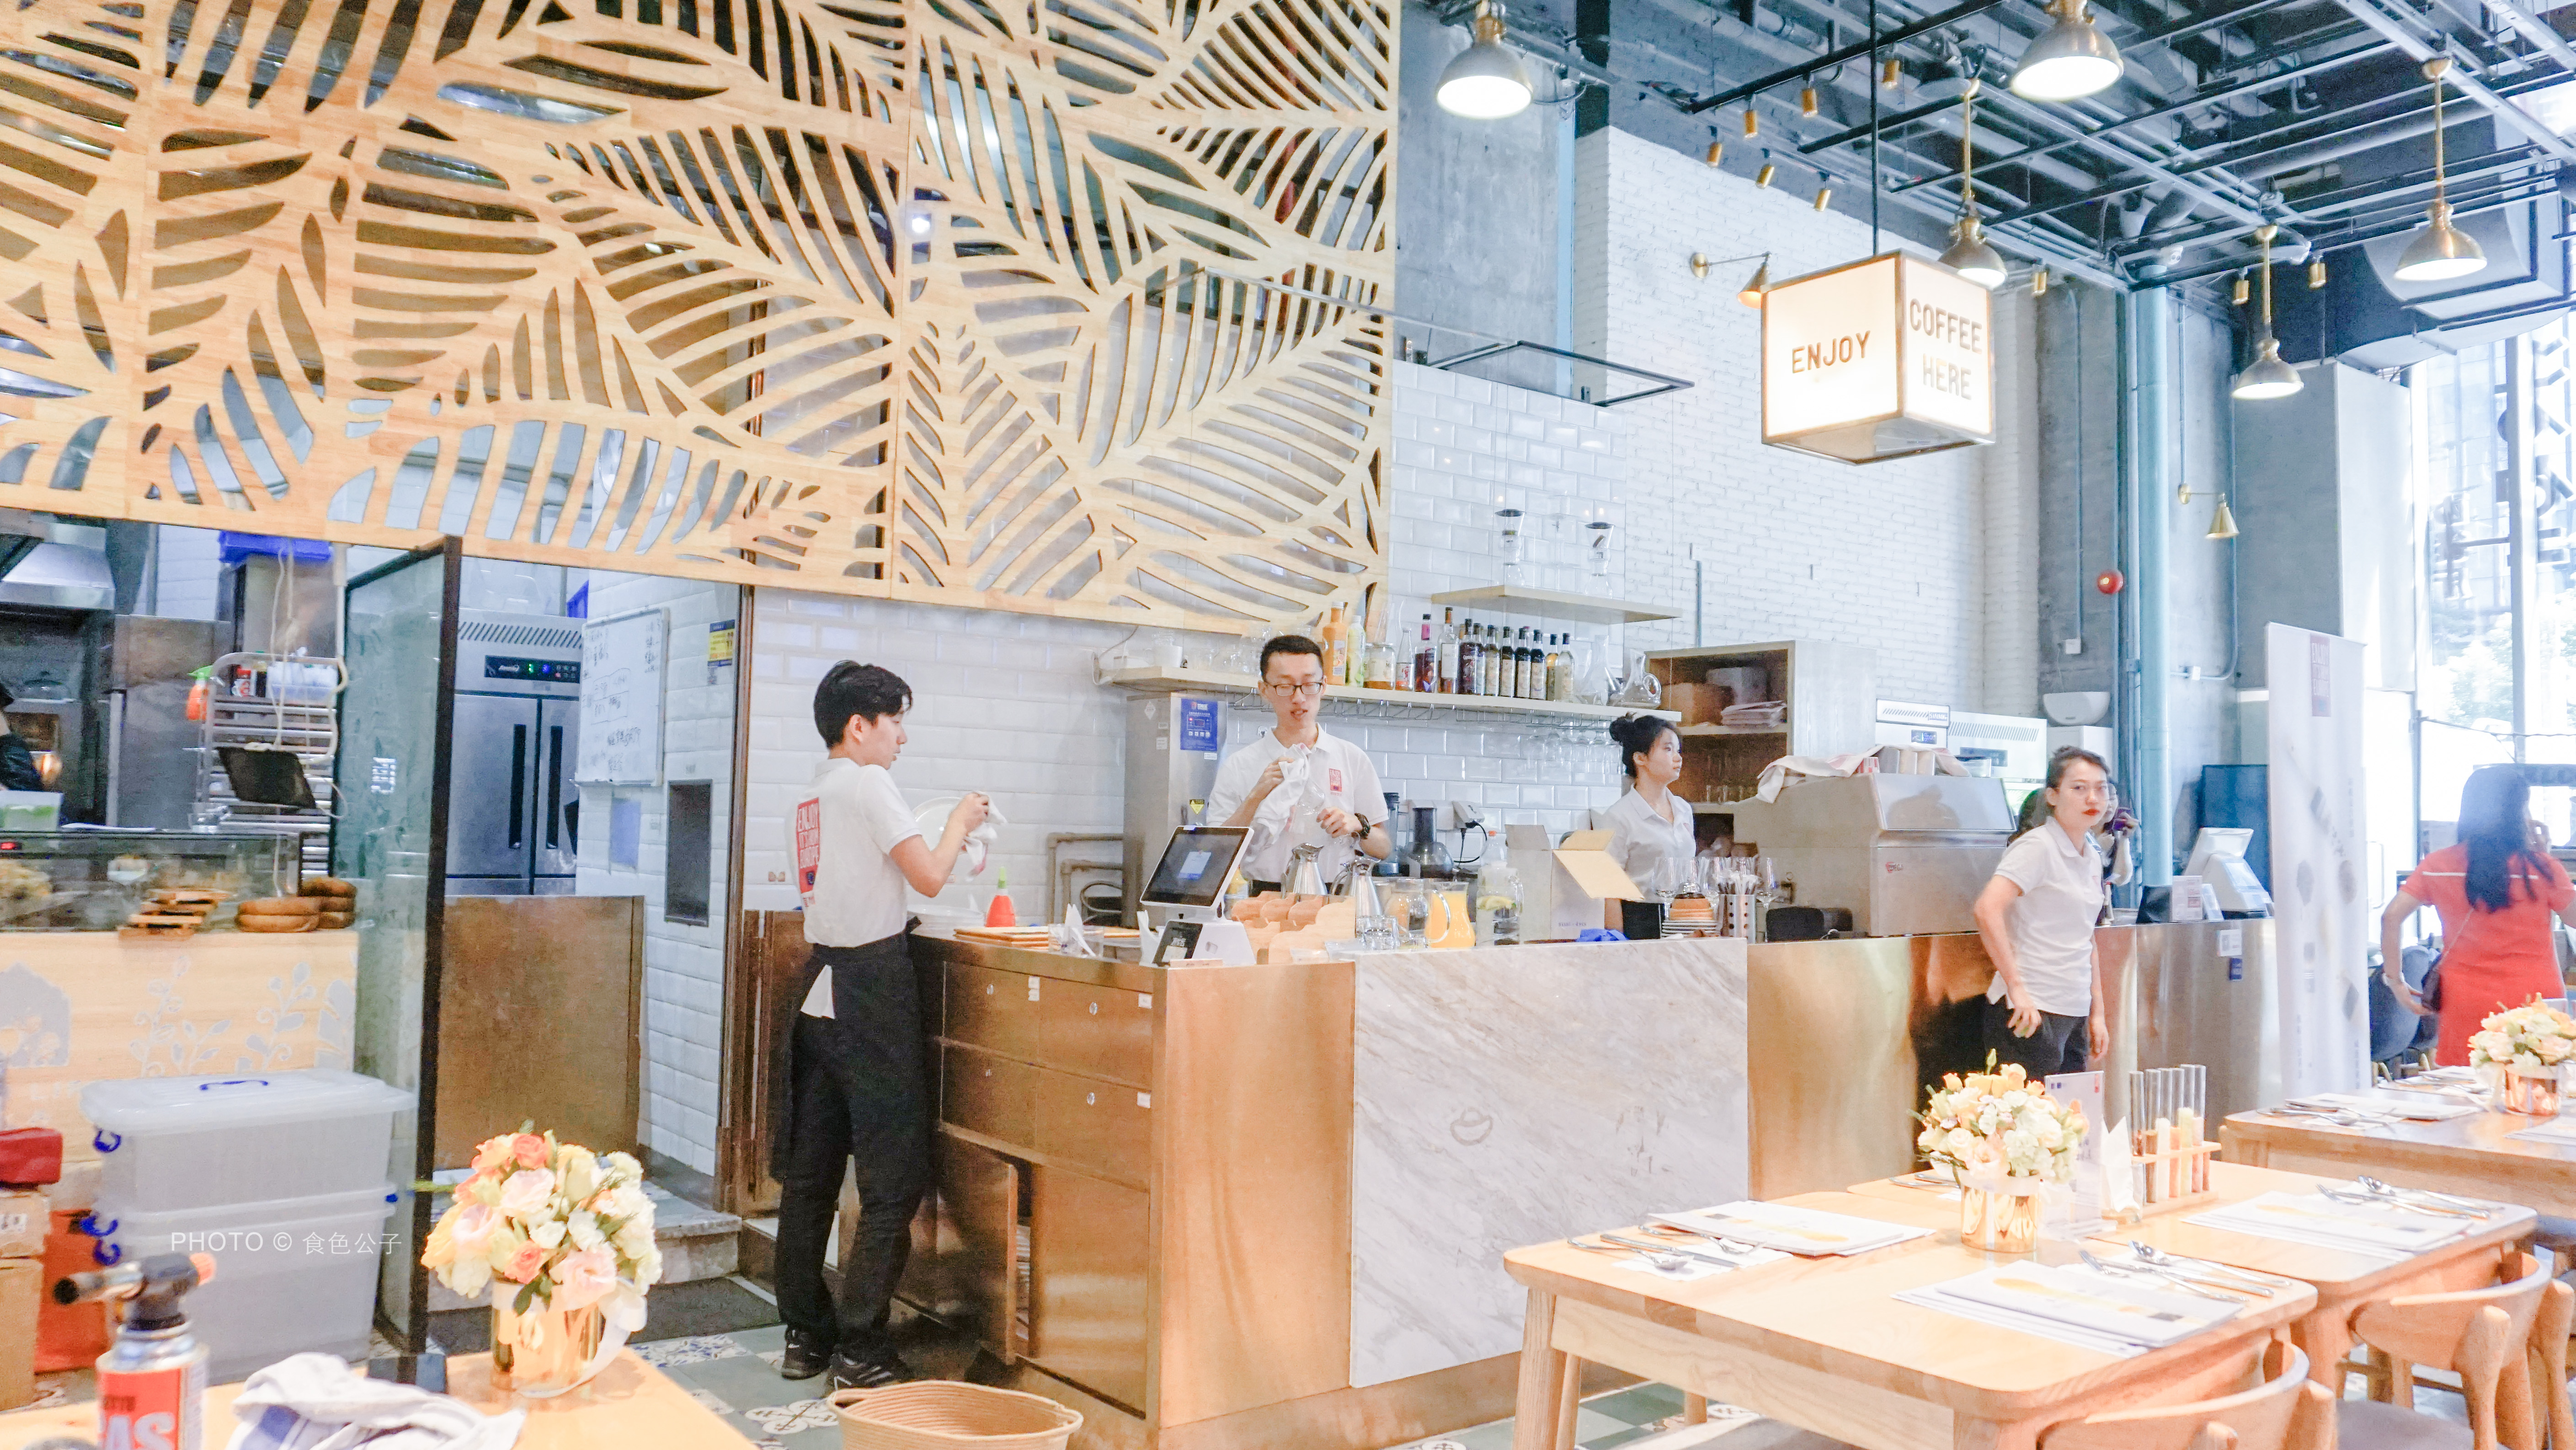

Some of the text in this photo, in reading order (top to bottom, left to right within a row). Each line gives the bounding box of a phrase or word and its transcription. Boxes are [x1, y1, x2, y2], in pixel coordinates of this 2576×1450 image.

[1910, 298, 1982, 354] COFFEE
[1792, 330, 1871, 374] ENJOY
[1923, 353, 1972, 400] HERE
[100, 1411, 179, 1450] AS
